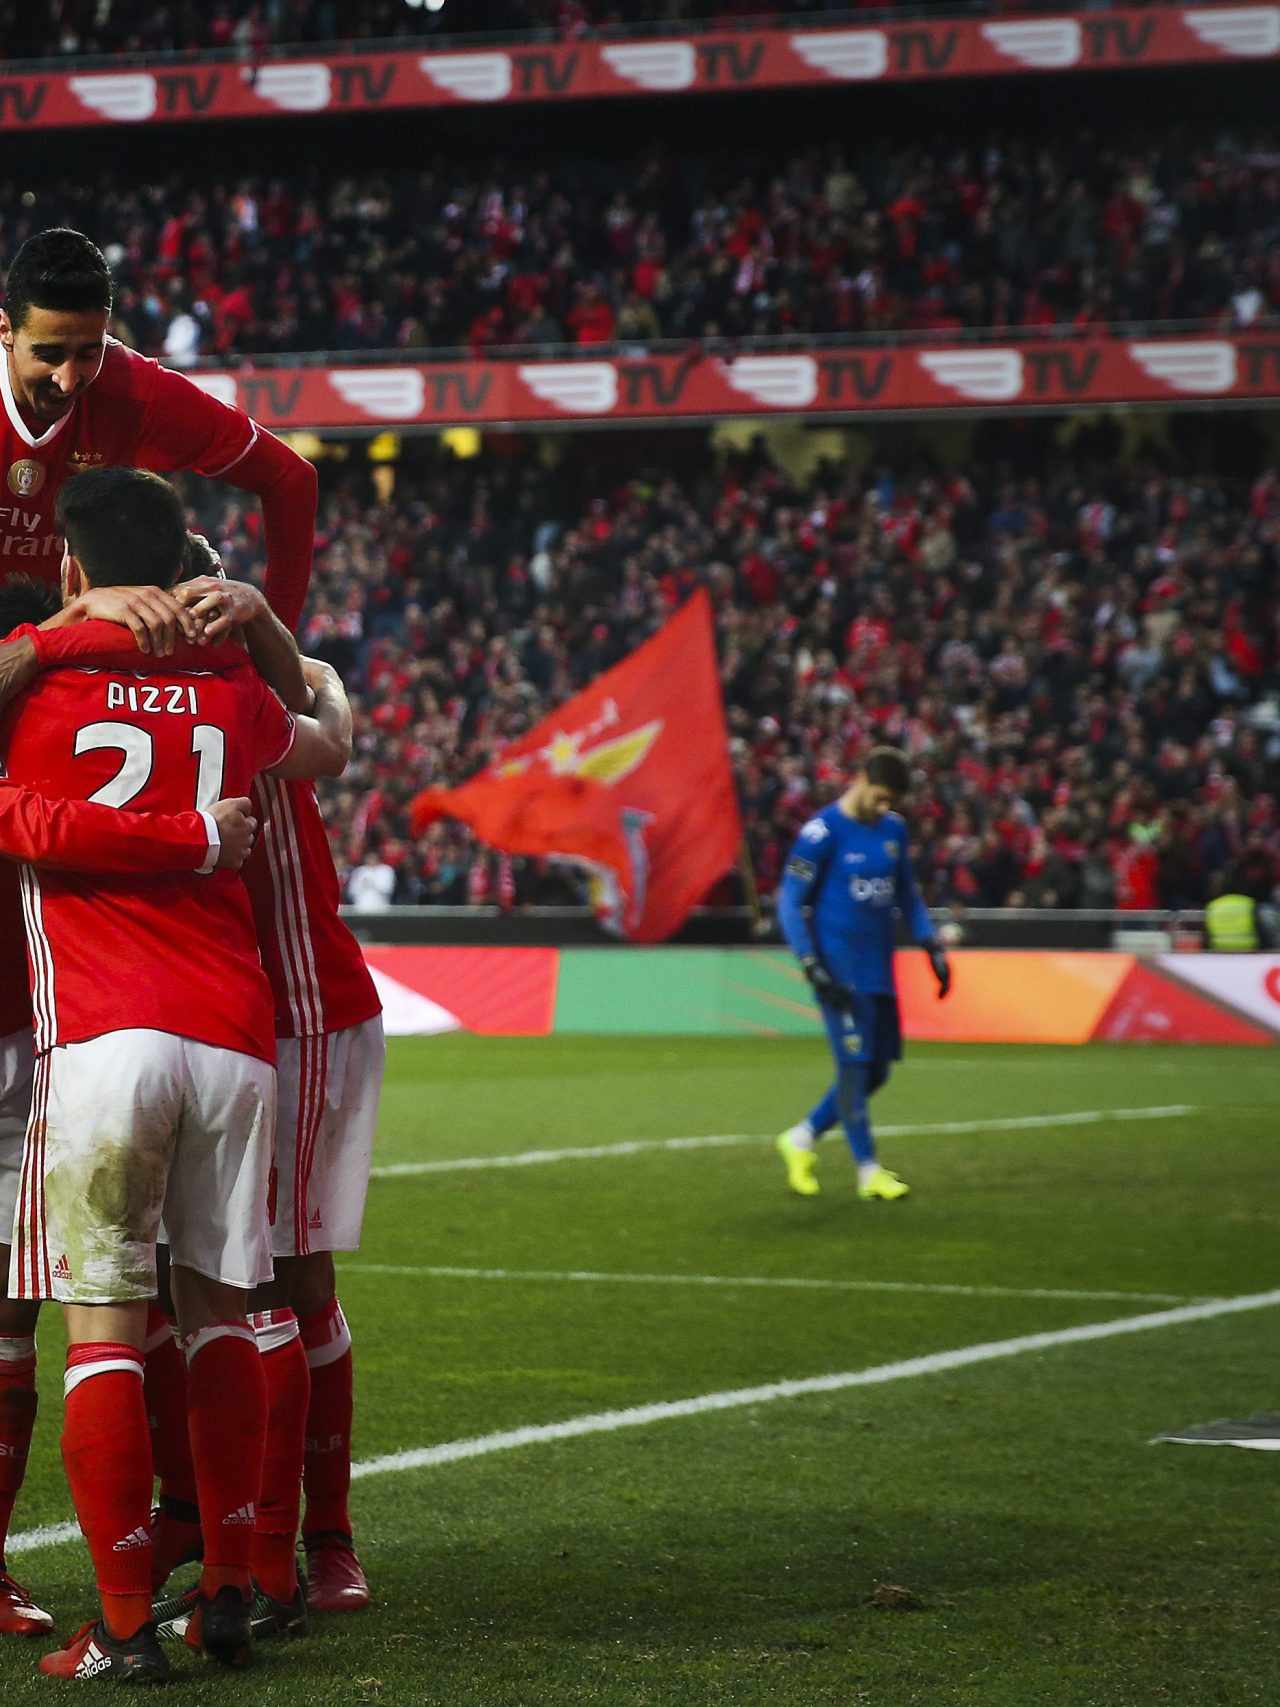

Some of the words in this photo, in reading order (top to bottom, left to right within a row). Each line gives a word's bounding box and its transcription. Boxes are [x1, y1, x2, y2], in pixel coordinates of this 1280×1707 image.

[106, 681, 199, 716] PIZZI
[73, 720, 226, 874] 21
[74, 1656, 112, 1680] adidas
